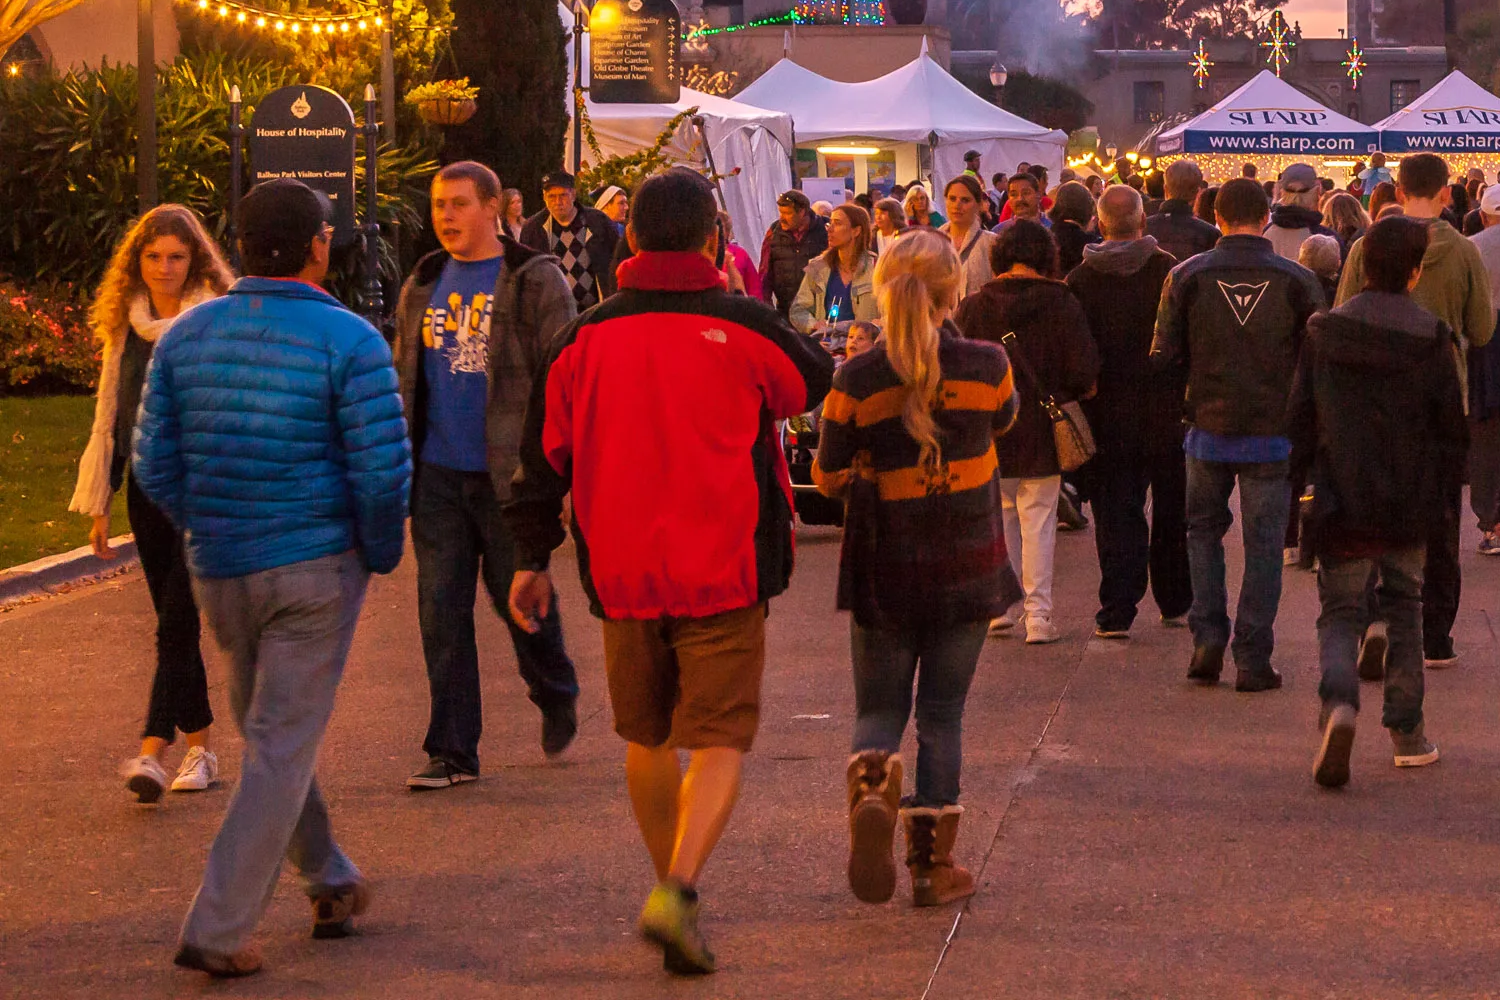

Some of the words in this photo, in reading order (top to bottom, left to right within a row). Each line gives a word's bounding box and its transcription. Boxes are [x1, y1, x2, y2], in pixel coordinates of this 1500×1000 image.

[594, 57, 623, 65] Japanese
[1228, 110, 1327, 126] SHARP
[256, 128, 285, 137] House
[287, 127, 297, 137] of
[298, 127, 347, 139] Hospitality
[1209, 133, 1355, 152] www.sharp.com
[324, 170, 347, 178] Center
